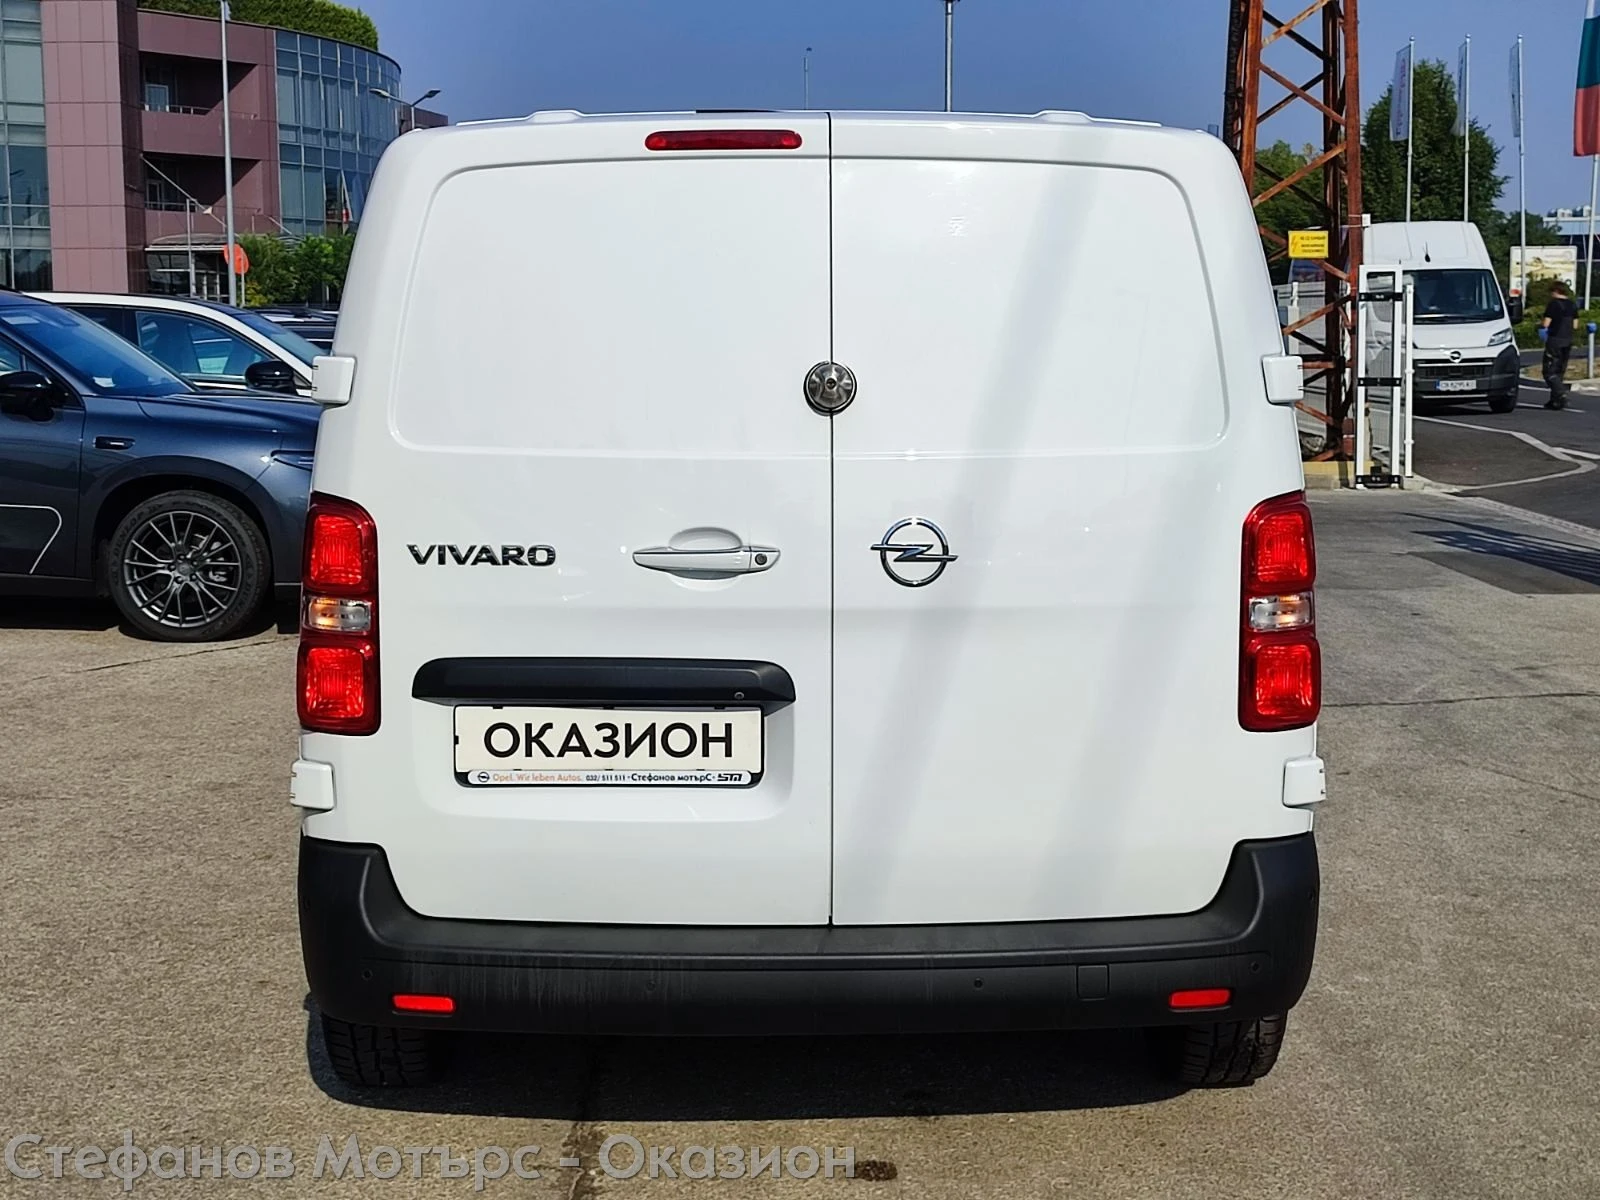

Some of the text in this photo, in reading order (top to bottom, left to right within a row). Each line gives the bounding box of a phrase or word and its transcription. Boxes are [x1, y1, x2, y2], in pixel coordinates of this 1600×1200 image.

[406, 544, 556, 566] VIVARO
[484, 722, 733, 759] ОКАЗИОН
[516, 773, 530, 782] Wir
[532, 773, 555, 782] leben
